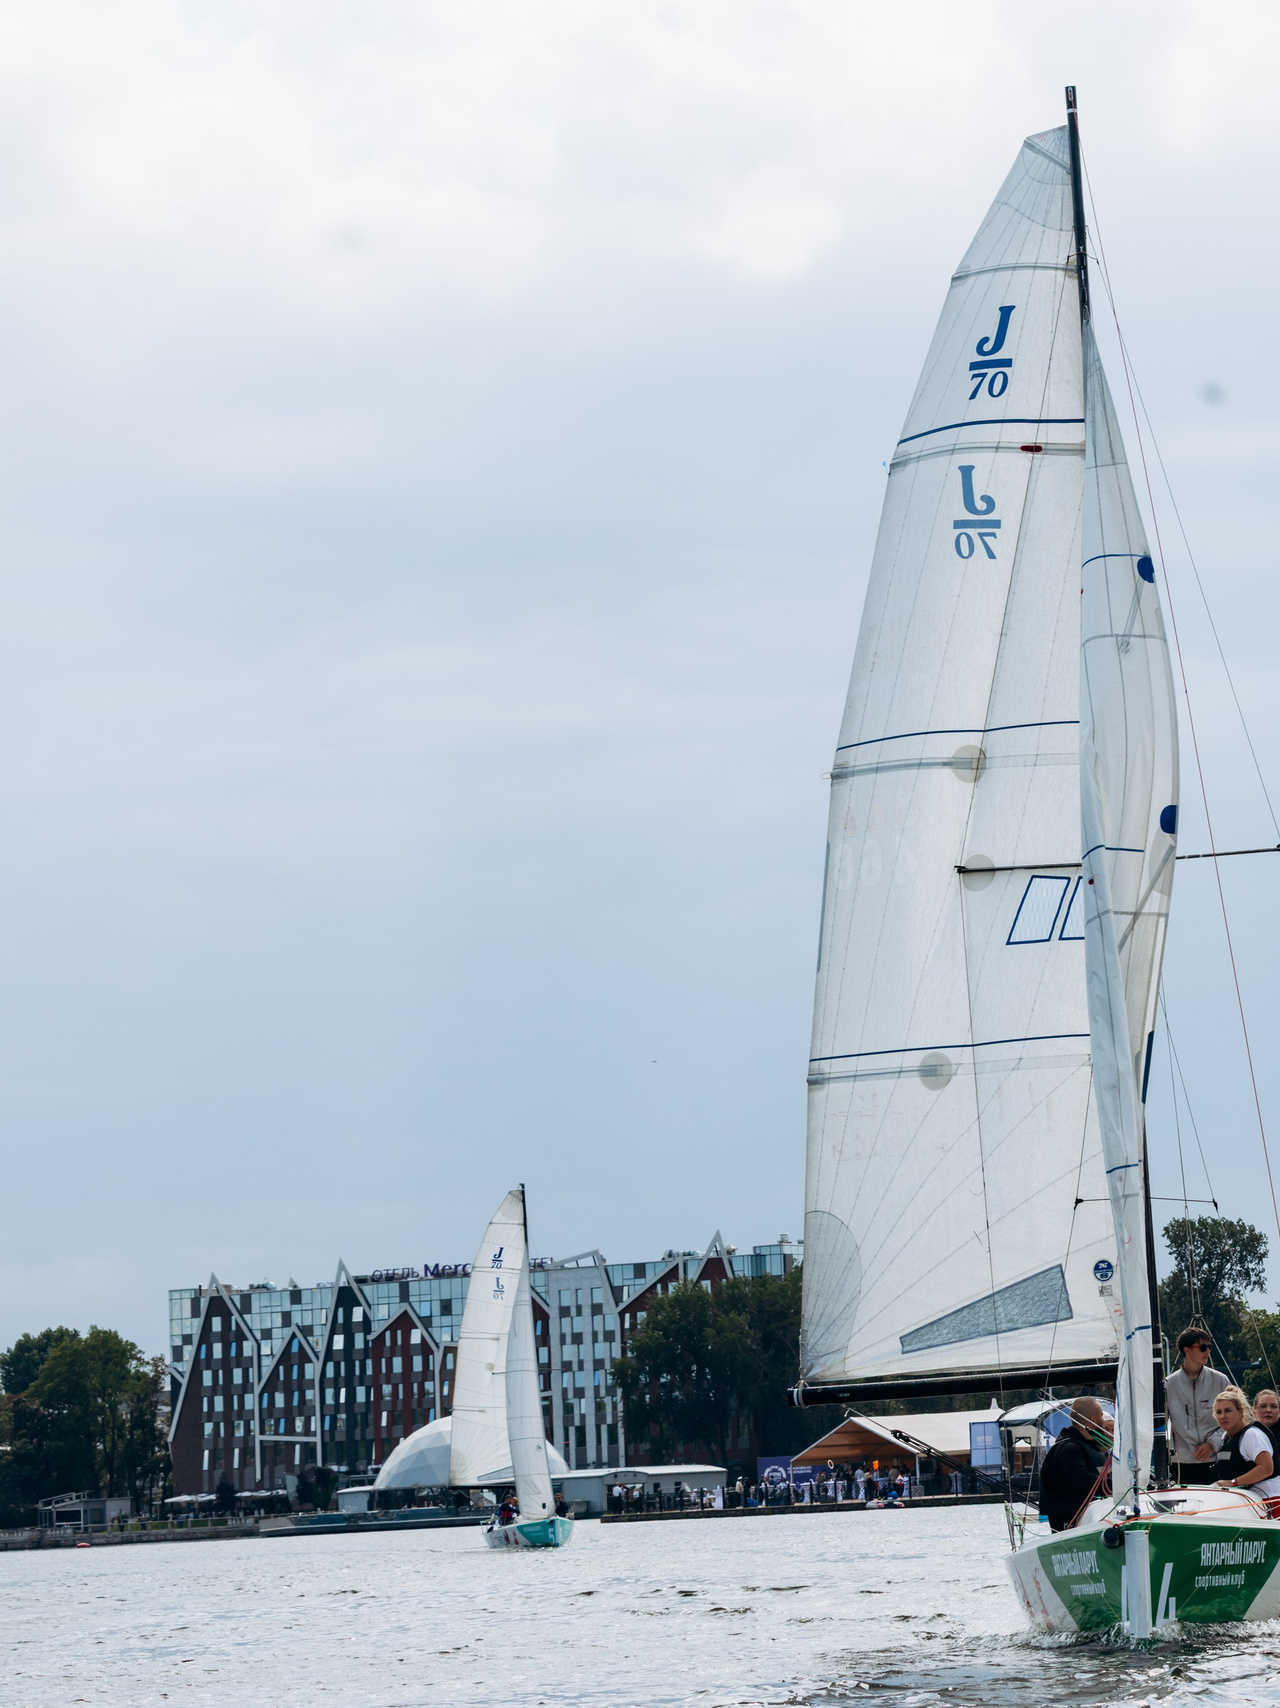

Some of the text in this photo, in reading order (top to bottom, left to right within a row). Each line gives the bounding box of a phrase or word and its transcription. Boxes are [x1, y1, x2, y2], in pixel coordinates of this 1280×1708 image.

[975, 305, 1016, 357] J
[968, 371, 1009, 400] 70
[490, 1261, 503, 1269] 70
[493, 1247, 504, 1259] J
[423, 1262, 473, 1279] Merc
[1200, 1537, 1267, 1567] ЯНТАРНЫЙ ПАРУС
[1155, 1562, 1178, 1628] 4
